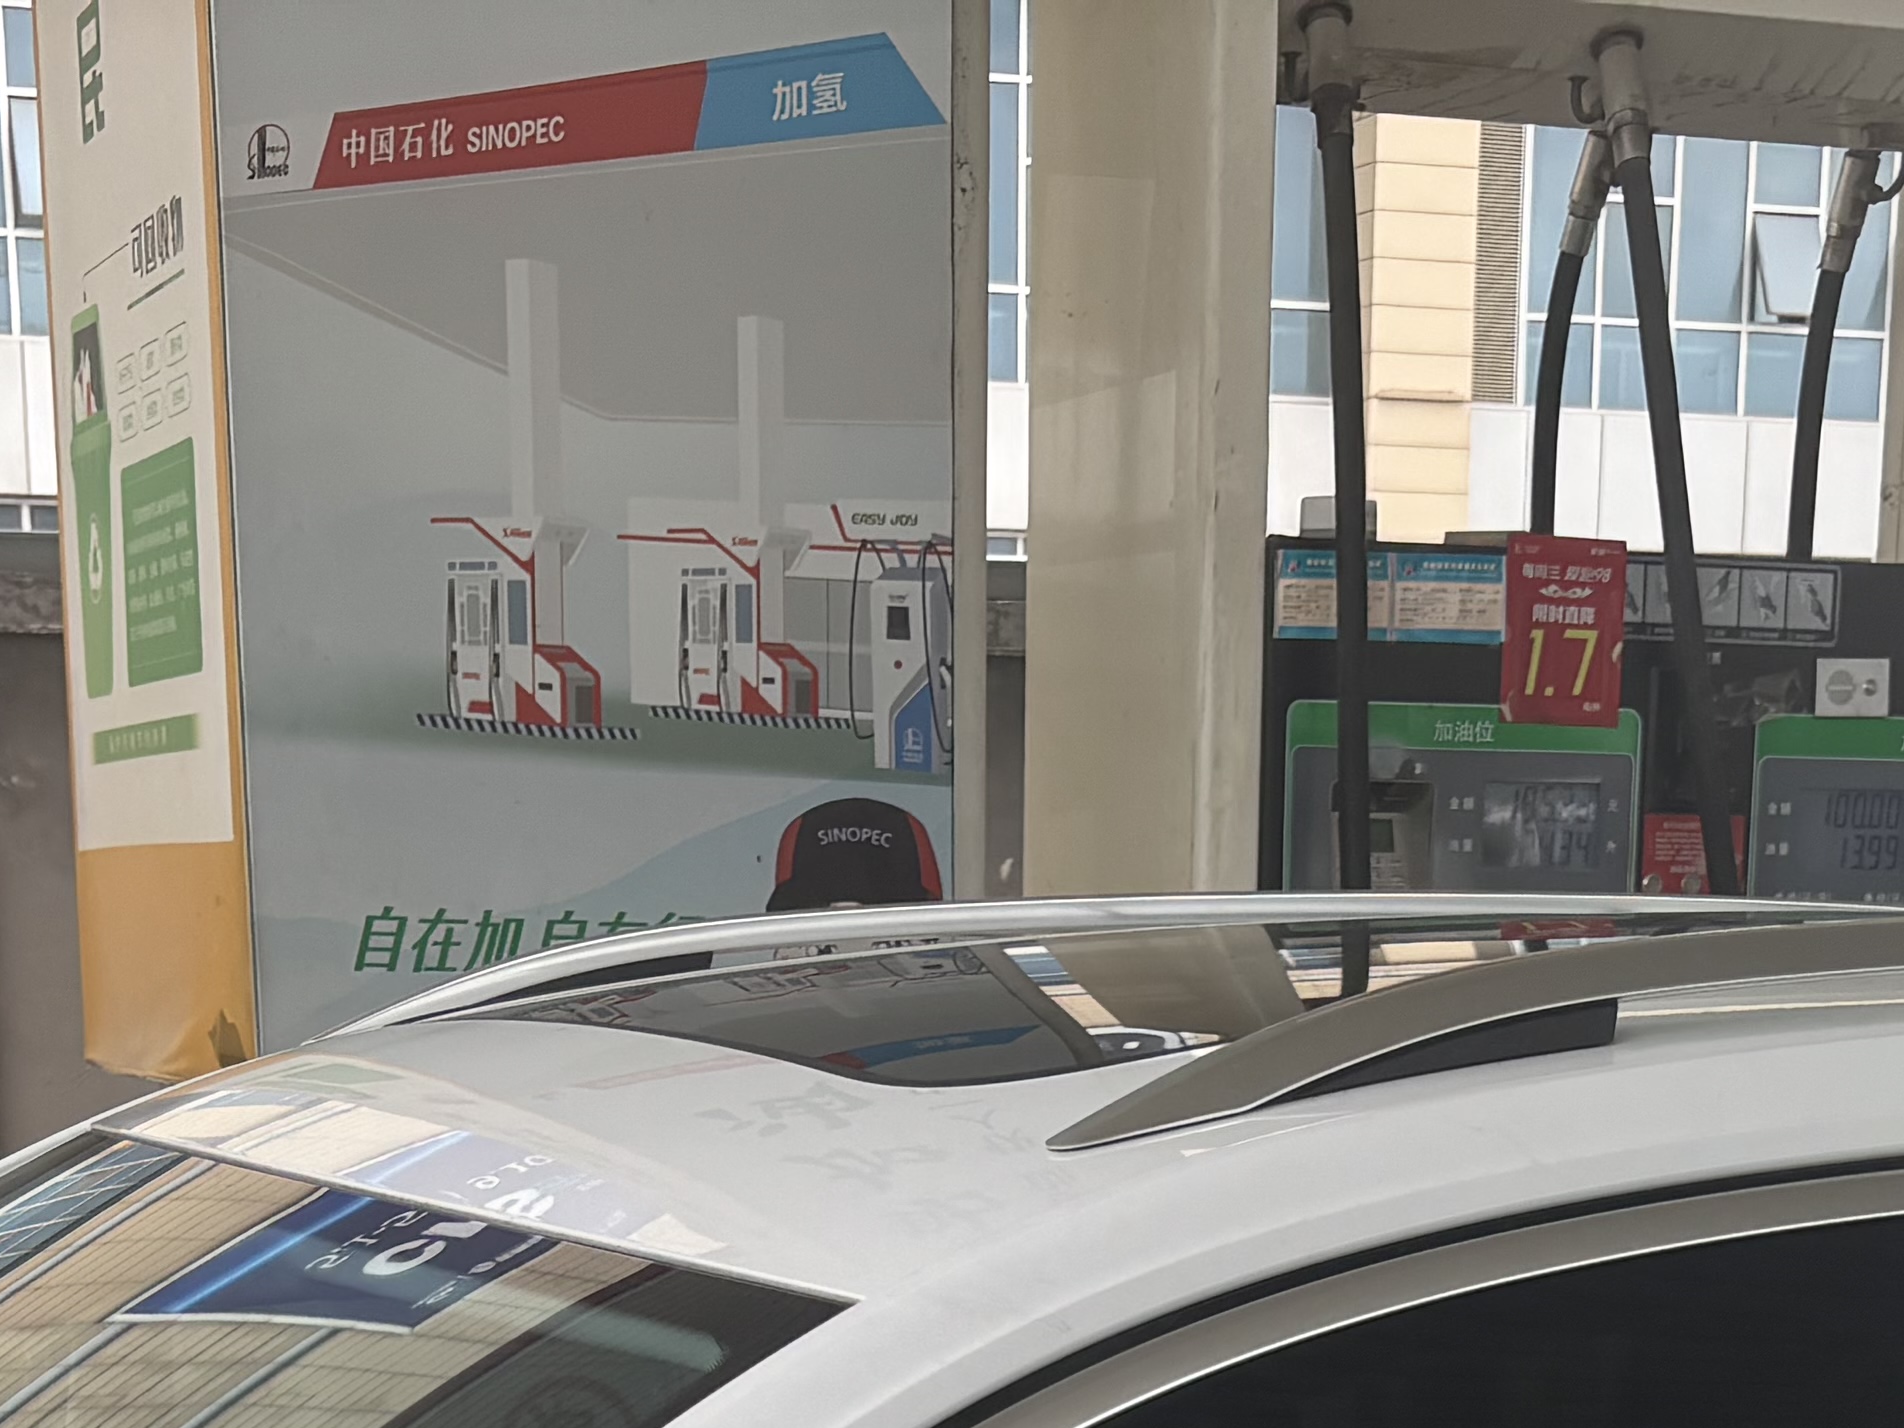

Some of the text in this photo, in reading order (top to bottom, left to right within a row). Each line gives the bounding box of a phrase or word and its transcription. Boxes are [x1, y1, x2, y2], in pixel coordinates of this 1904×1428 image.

[772, 72, 847, 121] 加氢
[341, 115, 566, 169] 中国石化 SINOPEC
[851, 512, 886, 526] EASY
[1524, 628, 1599, 696] 1.7
[1433, 719, 1495, 743] 加油位
[817, 827, 893, 848] SINOPEC
[354, 906, 525, 973] 自在加
